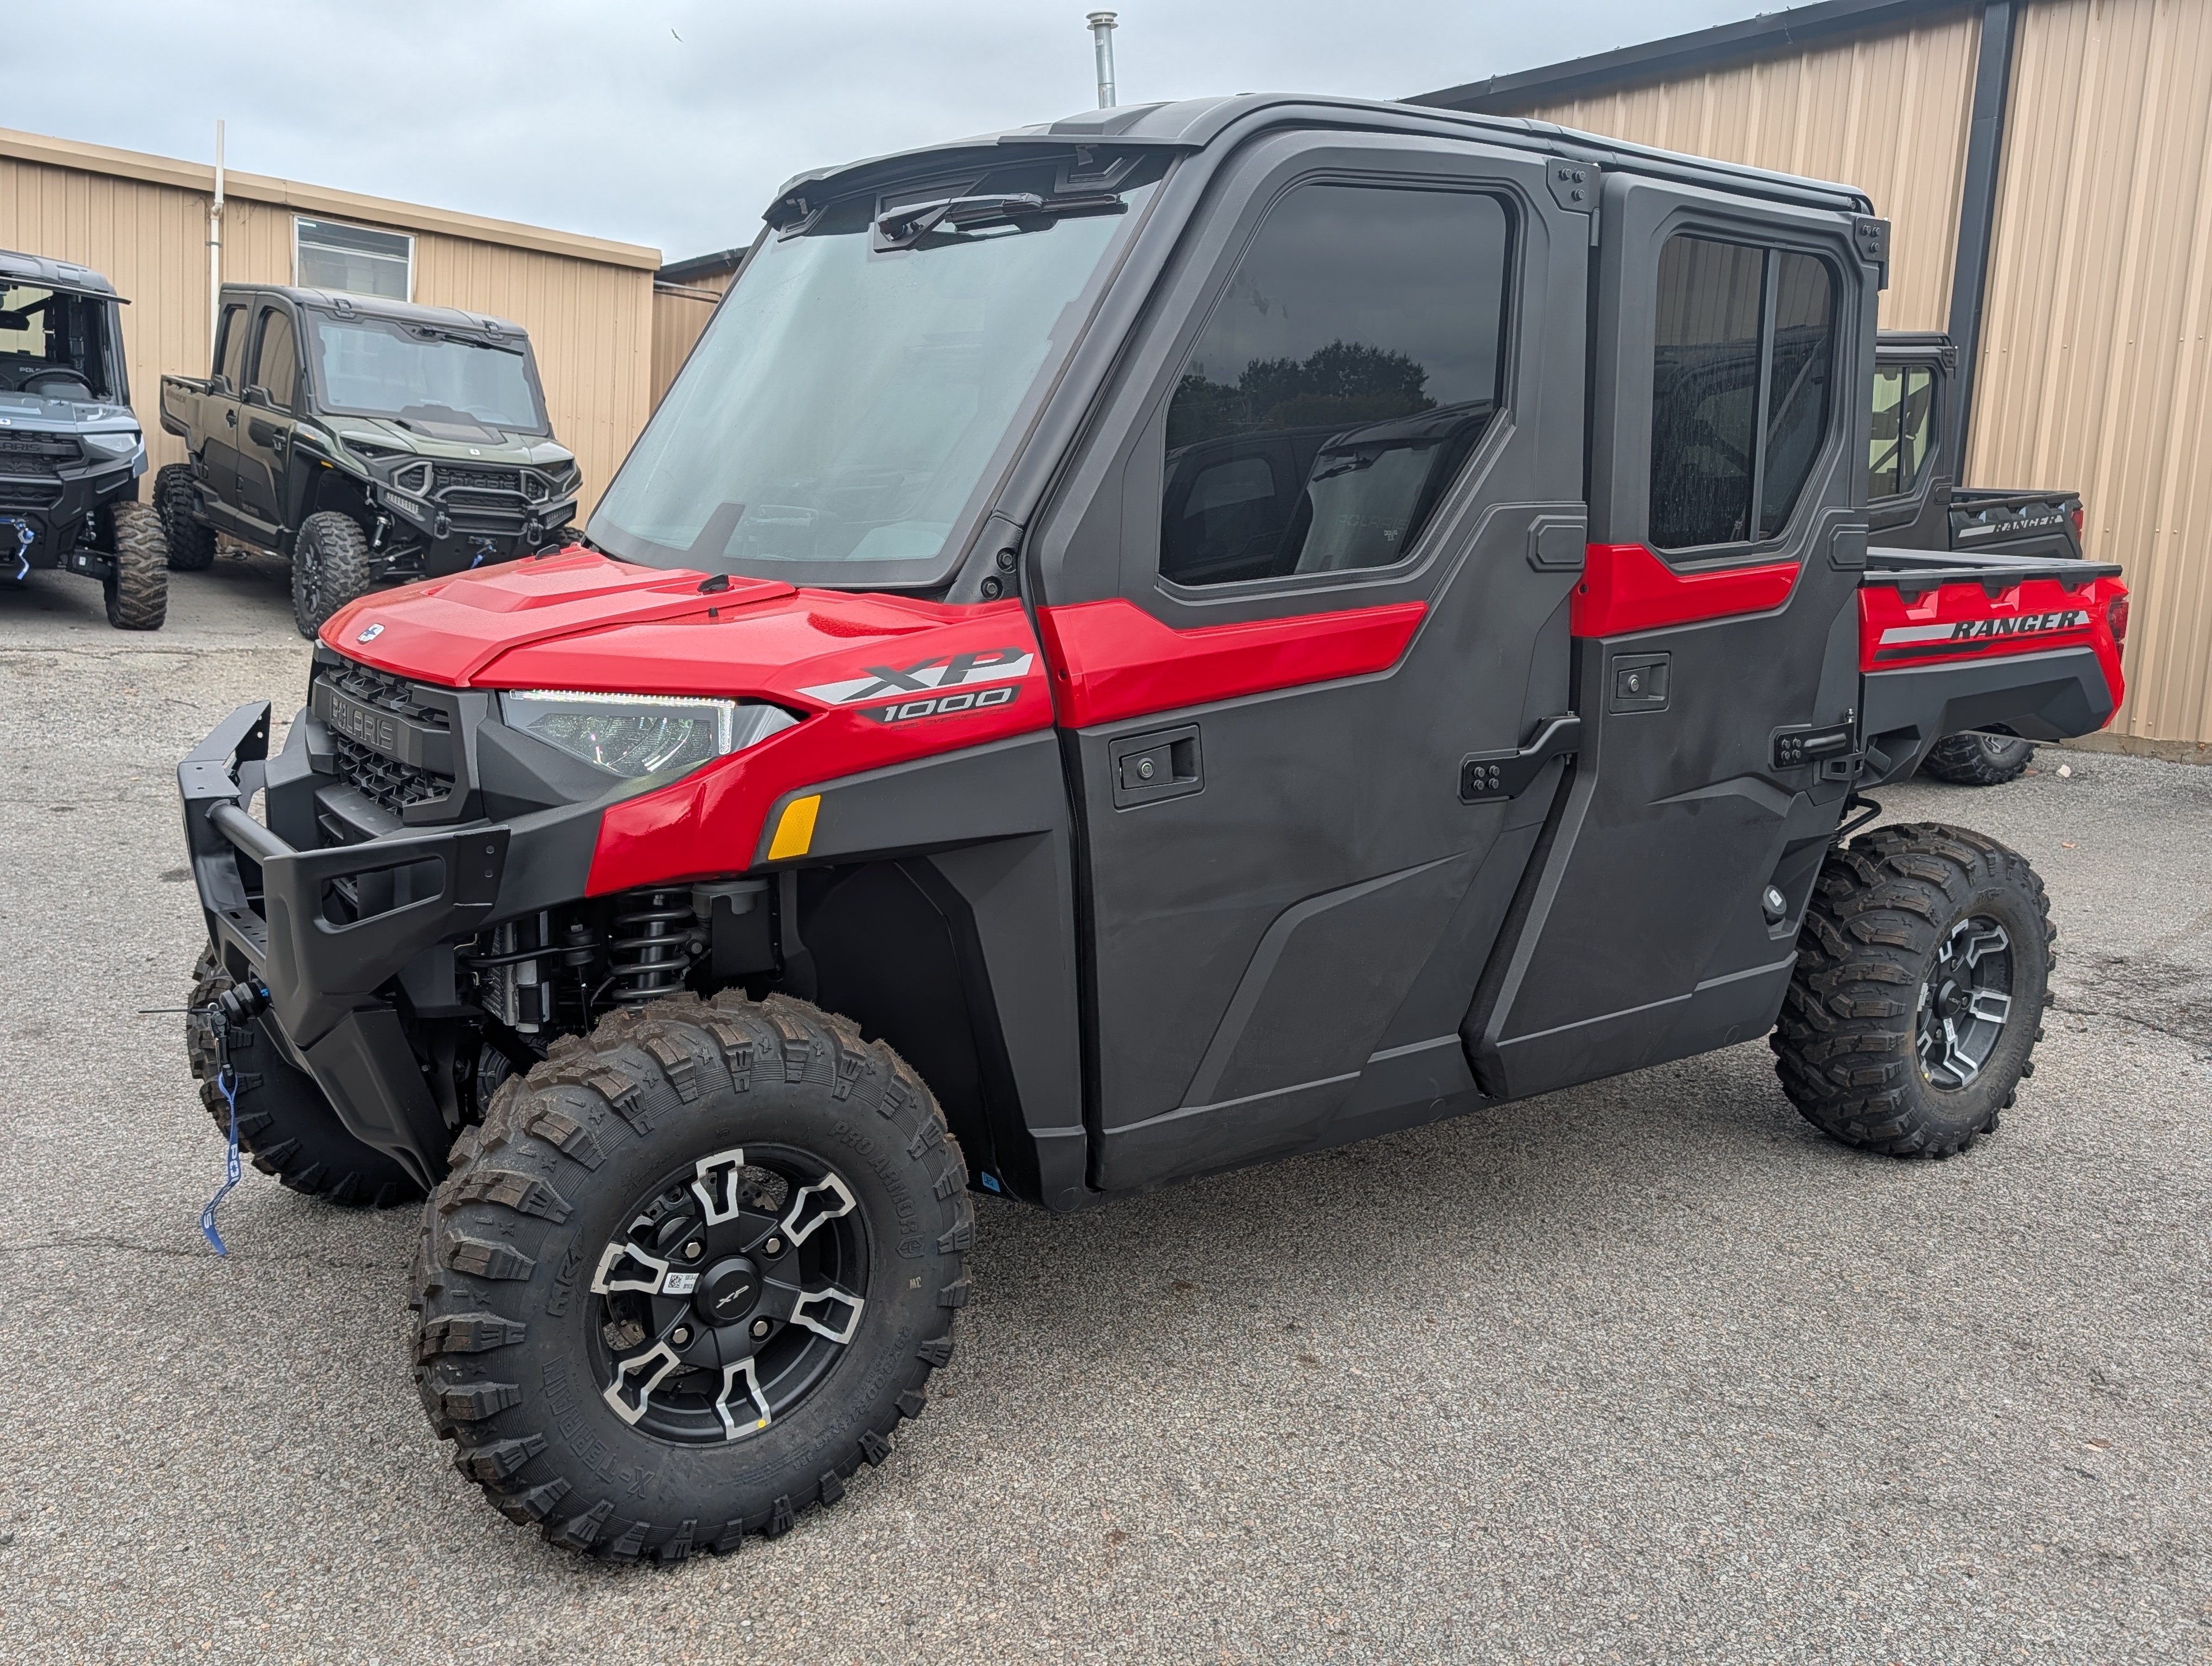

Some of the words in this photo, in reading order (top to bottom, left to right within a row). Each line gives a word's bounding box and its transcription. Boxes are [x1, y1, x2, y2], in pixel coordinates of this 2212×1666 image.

[1337, 515, 1410, 530] POLARIS
[1994, 515, 2059, 533] RANGER
[1950, 610, 2080, 640] RANGER
[838, 646, 1029, 702] XP
[884, 688, 1012, 722] 1000
[331, 695, 394, 750] POLARIS
[827, 1120, 875, 1156] PRO
[867, 1154, 919, 1234] ARMOR
[716, 1285, 749, 1309] XP
[542, 1355, 655, 1498] X-TERRAIN
